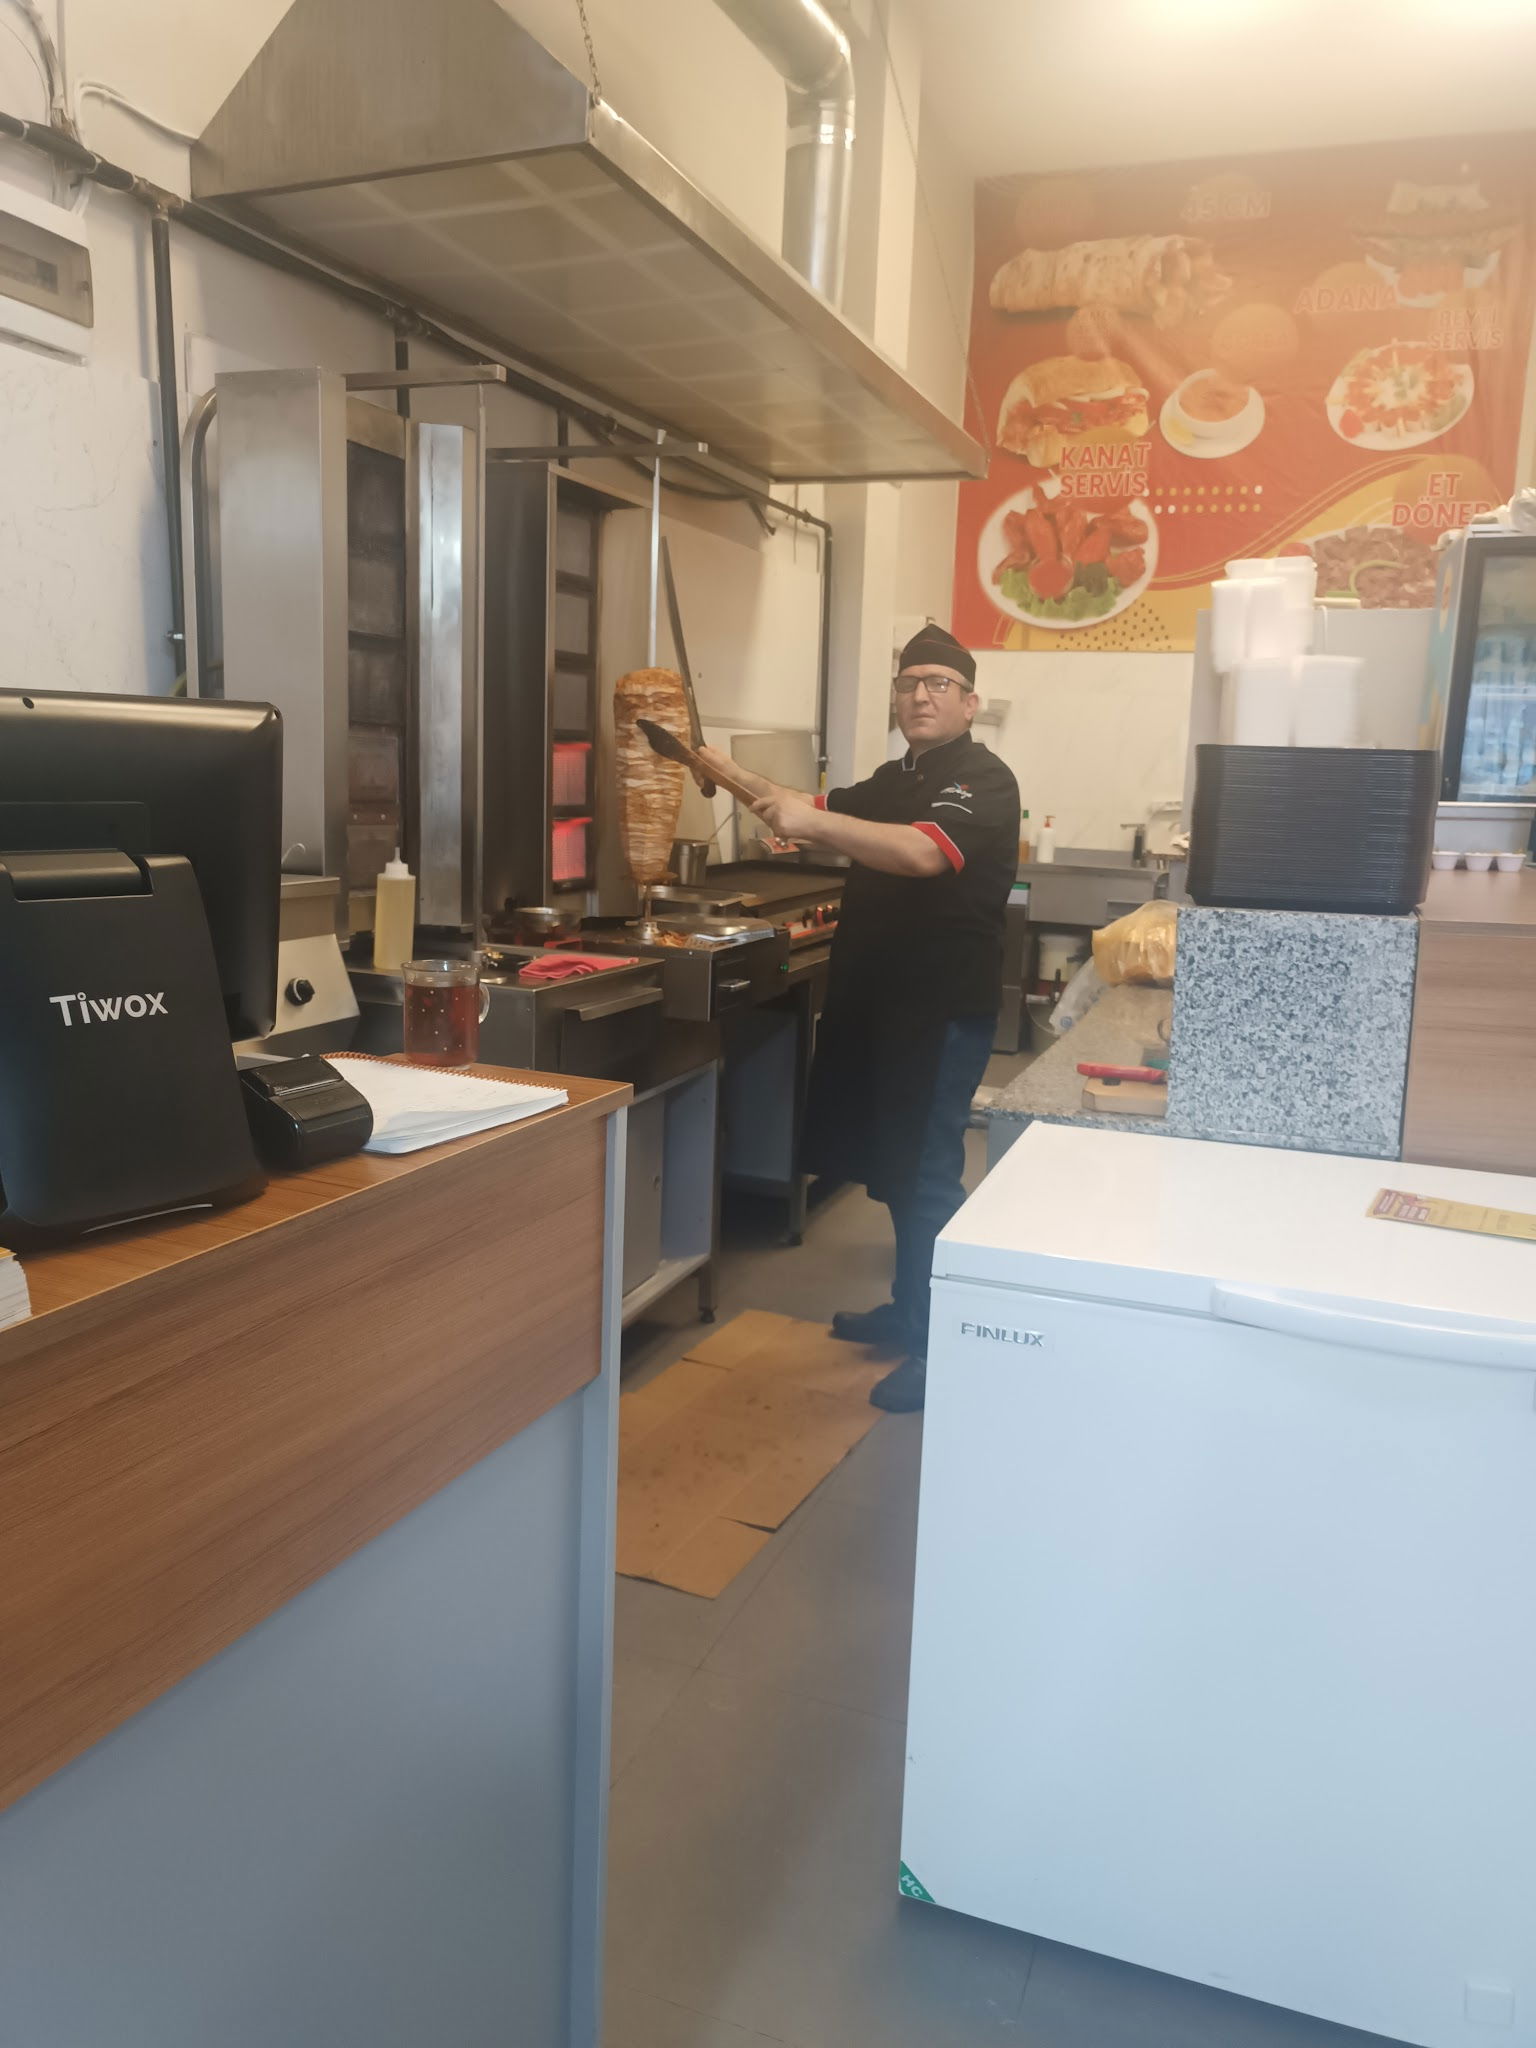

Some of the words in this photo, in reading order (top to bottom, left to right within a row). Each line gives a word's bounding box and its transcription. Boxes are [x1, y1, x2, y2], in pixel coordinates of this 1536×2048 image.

[1293, 286, 1398, 315] ADANA
[1060, 441, 1152, 469] KANAT
[1060, 466, 1149, 498] SERVİS
[1427, 472, 1462, 497] ET
[960, 1321, 1047, 1347] FINLUX
[901, 1874, 924, 1898] HC
